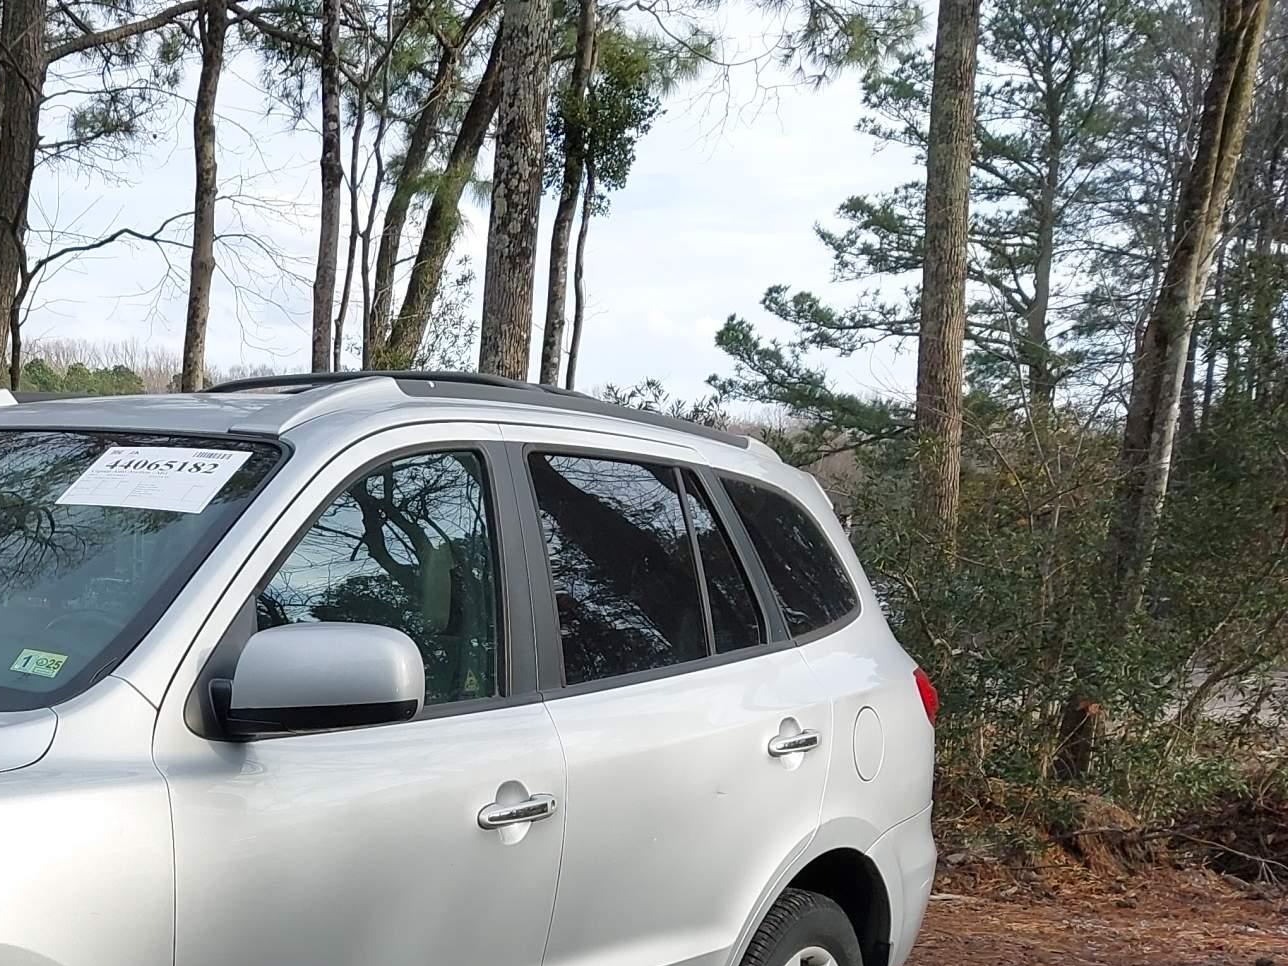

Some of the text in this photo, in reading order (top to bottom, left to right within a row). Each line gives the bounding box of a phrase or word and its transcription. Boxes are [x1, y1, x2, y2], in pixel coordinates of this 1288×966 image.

[105, 458, 219, 474] 44065182
[22, 654, 62, 670] 1 25
